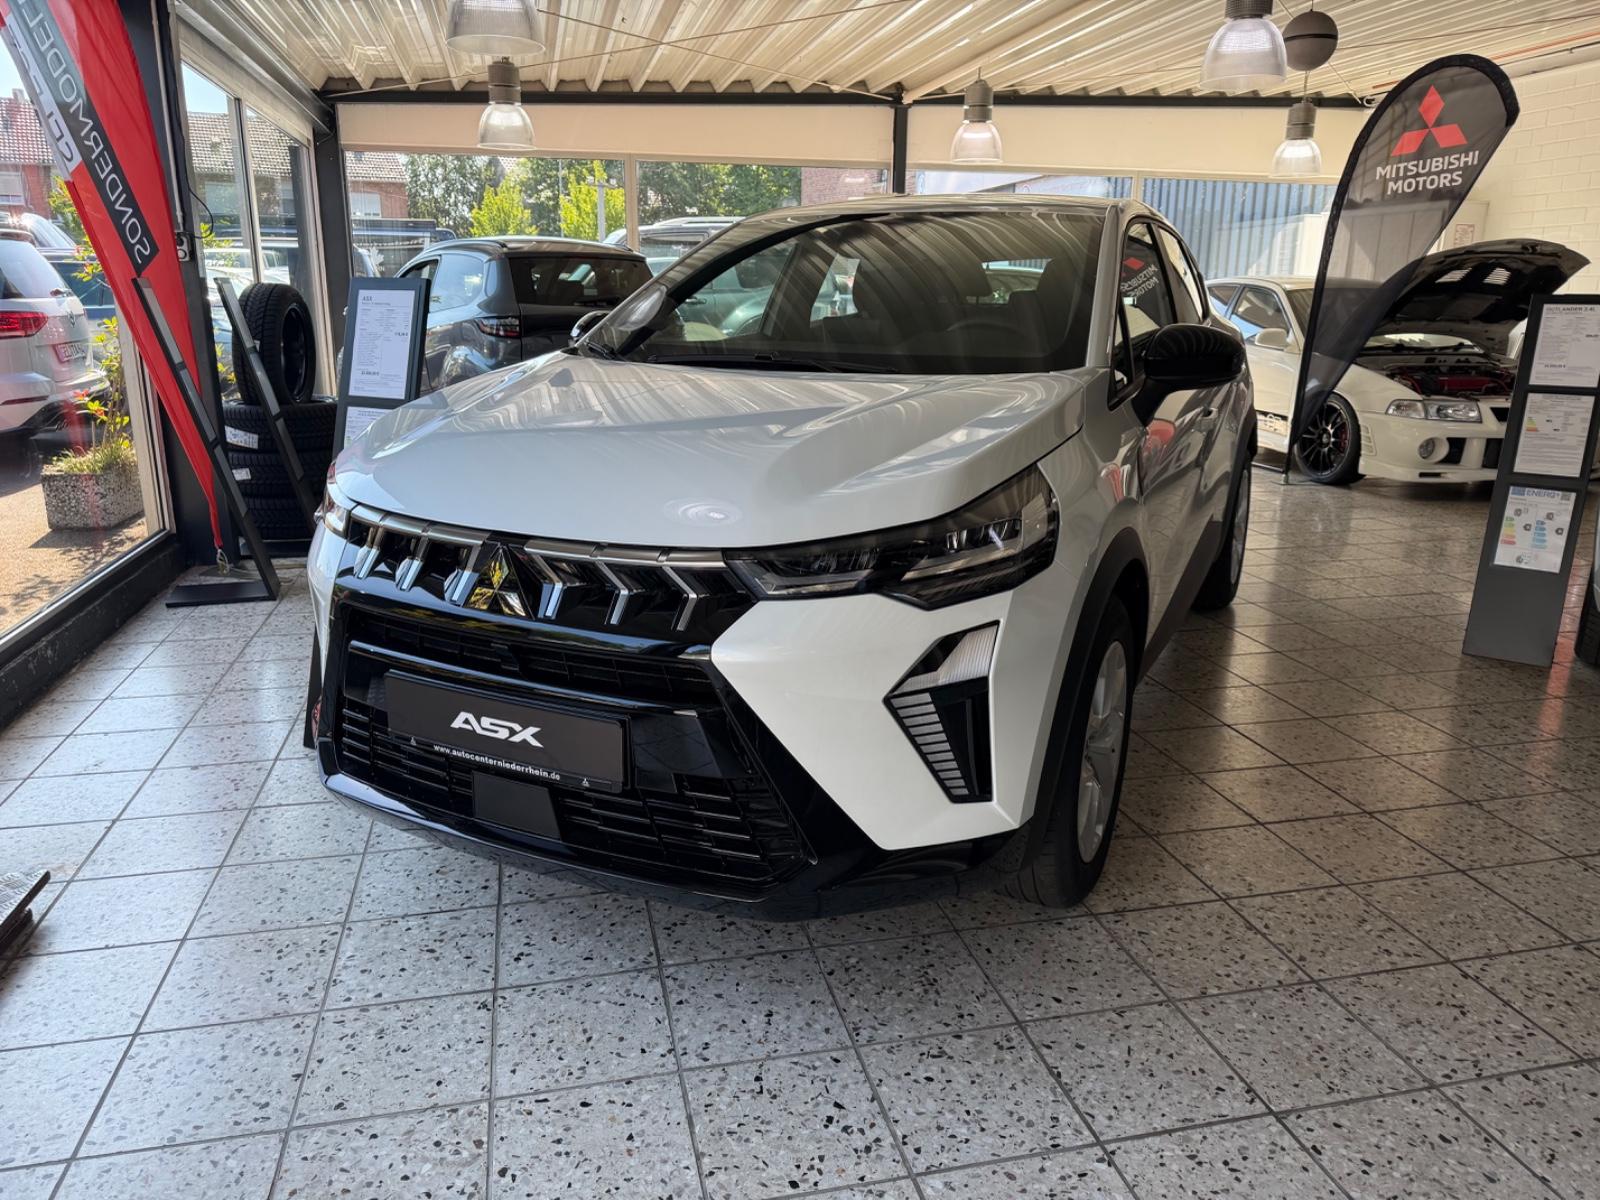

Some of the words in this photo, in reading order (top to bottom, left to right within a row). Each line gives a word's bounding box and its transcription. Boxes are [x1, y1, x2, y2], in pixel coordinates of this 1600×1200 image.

[1376, 150, 1480, 180] MITSUBISHI
[1387, 171, 1463, 195] MOTORS
[450, 711, 544, 748] ASX
[433, 744, 560, 781] www.autocenterniederrhein.de
